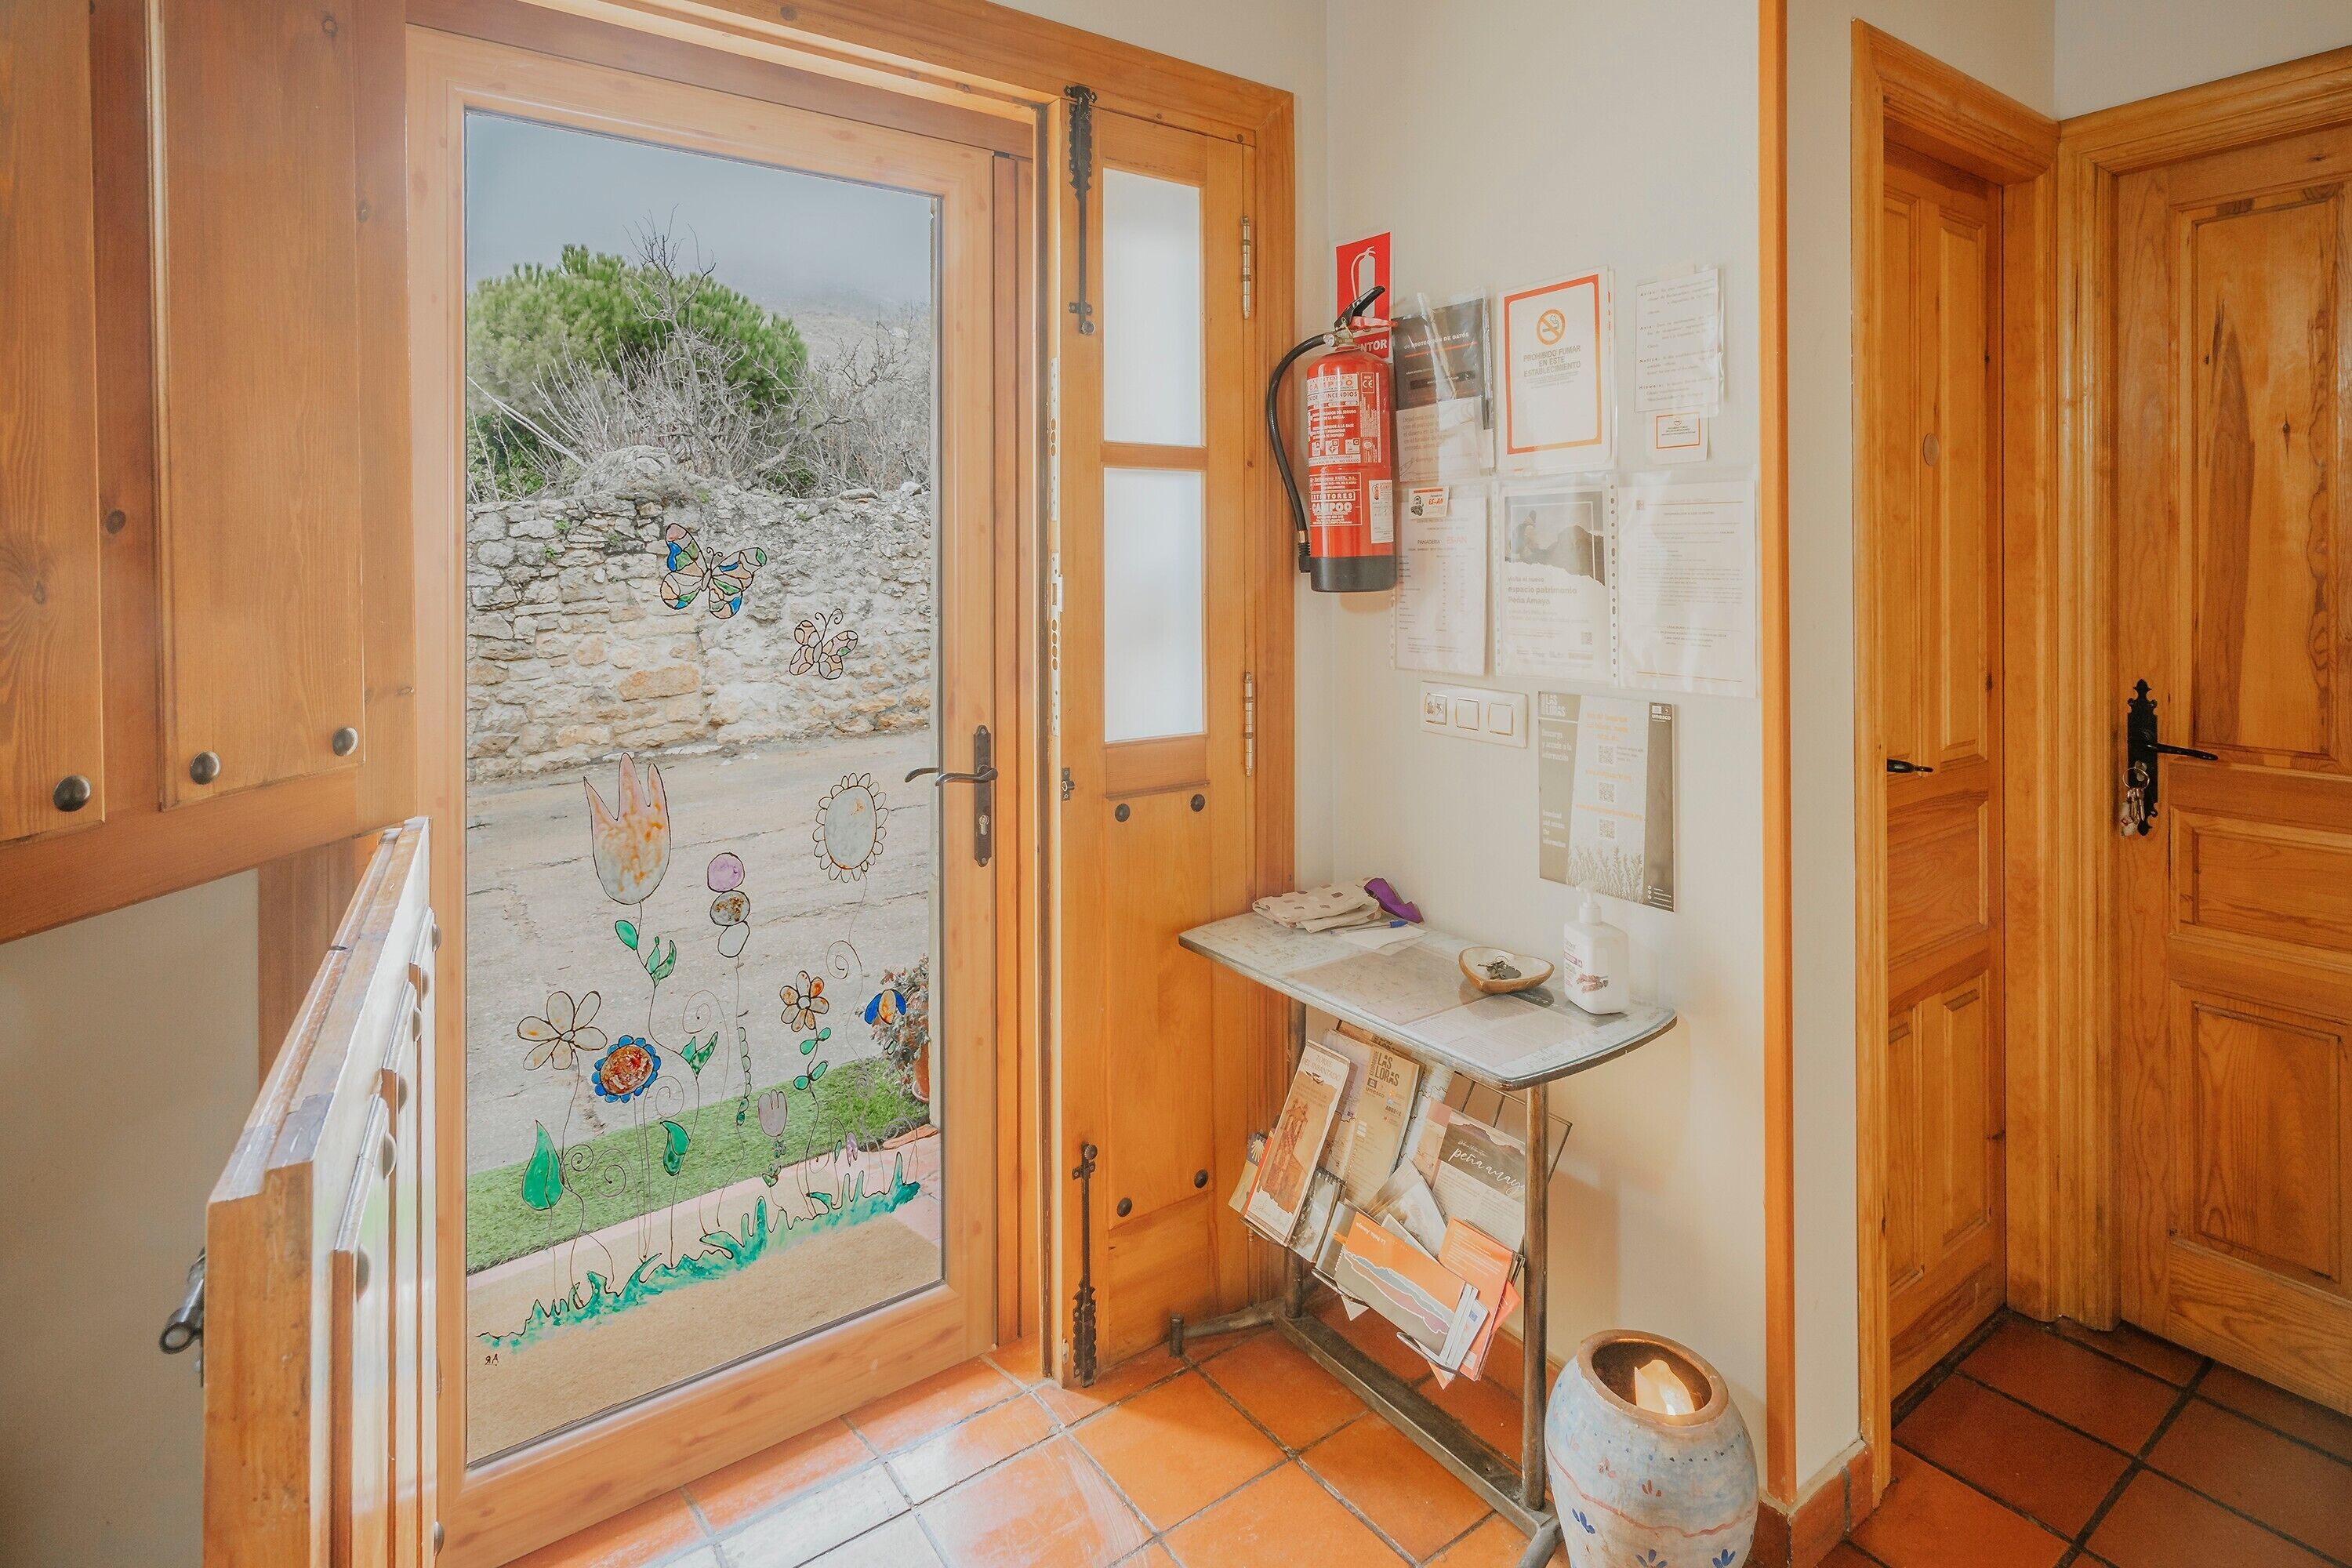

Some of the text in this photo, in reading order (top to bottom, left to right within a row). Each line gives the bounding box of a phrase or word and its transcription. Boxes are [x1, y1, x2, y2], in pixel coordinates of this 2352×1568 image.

[1452, 332, 1470, 340] DATOS
[1357, 339, 1388, 352] INTOR
[1523, 345, 1581, 362] PROHIBIDO FUMAR
[1549, 356, 1566, 365] ESTE
[1524, 361, 1581, 378] ESTABLECIMIENTO
[1508, 585, 1577, 595] espacio patrimonio
[1526, 596, 1550, 606] Amaya
[1377, 1052, 1394, 1070] LAS
[1374, 1065, 1401, 1087] LORAS
[1365, 1086, 1386, 1098] unesco
[1448, 1148, 1486, 1169] peña
[1486, 1165, 1526, 1197] amay
